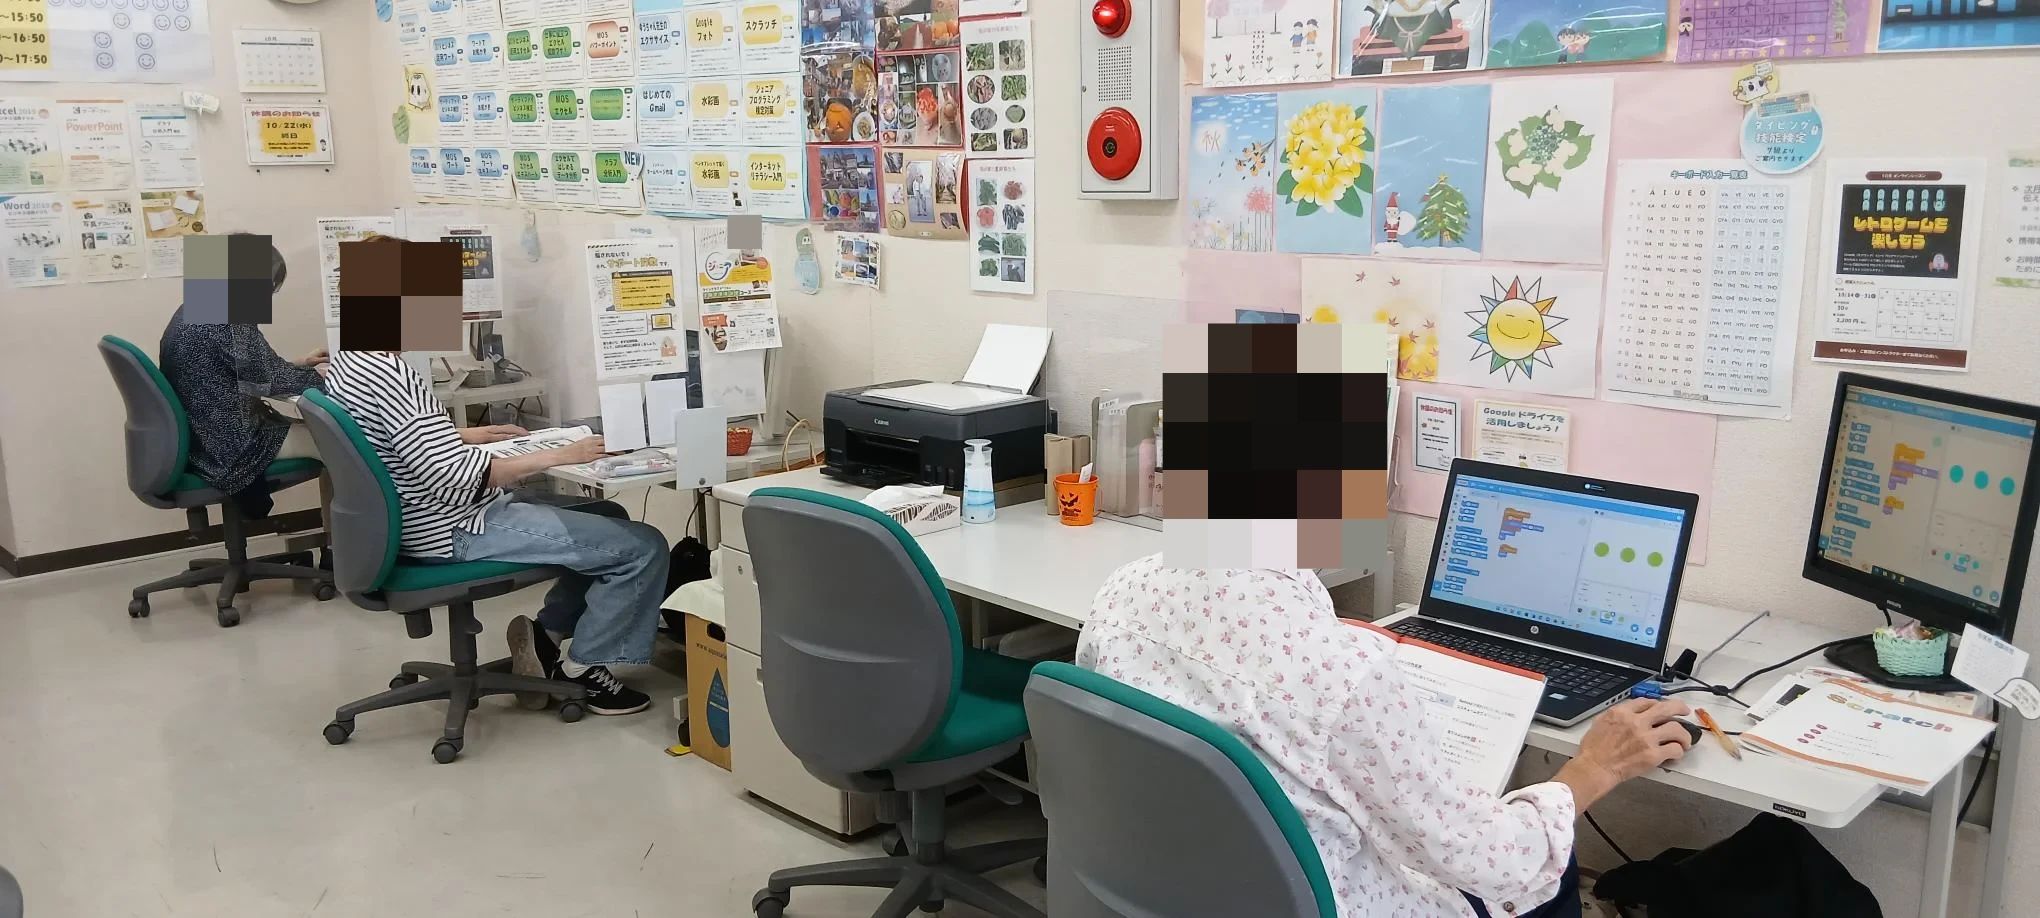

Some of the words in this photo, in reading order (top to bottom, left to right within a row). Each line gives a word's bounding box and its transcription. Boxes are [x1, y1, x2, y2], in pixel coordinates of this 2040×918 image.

[696, 18, 712, 28] Google
[745, 18, 778, 32] スクラッチ
[640, 34, 669, 44] エクササイズ
[698, 32, 712, 41] フォト
[755, 84, 774, 94] ジュニア
[556, 94, 569, 103] MOS
[642, 90, 672, 99] はじめての
[749, 95, 781, 104] プログラミング
[701, 95, 720, 106] 水彩画
[649, 102, 666, 112] Gmail
[66, 122, 124, 132] PowerPoint
[1756, 119, 1811, 130] タイピング
[1756, 132, 1808, 144] 技能検定
[624, 151, 640, 166] NEW
[750, 162, 782, 171] インターネット
[702, 170, 720, 180] 水彩画
[750, 171, 783, 182] リテラシー入門
[3, 202, 30, 210] Word
[1853, 216, 1950, 234] レトロゲームを
[1871, 233, 1926, 250] 楽しもう
[1484, 407, 1516, 418] Google
[1518, 409, 1565, 424] ドライブを
[874, 418, 890, 426] Canon
[1486, 417, 1560, 433] 活用しましょう！
[1826, 692, 1953, 734] Scratch
[1867, 720, 1882, 730] 1
